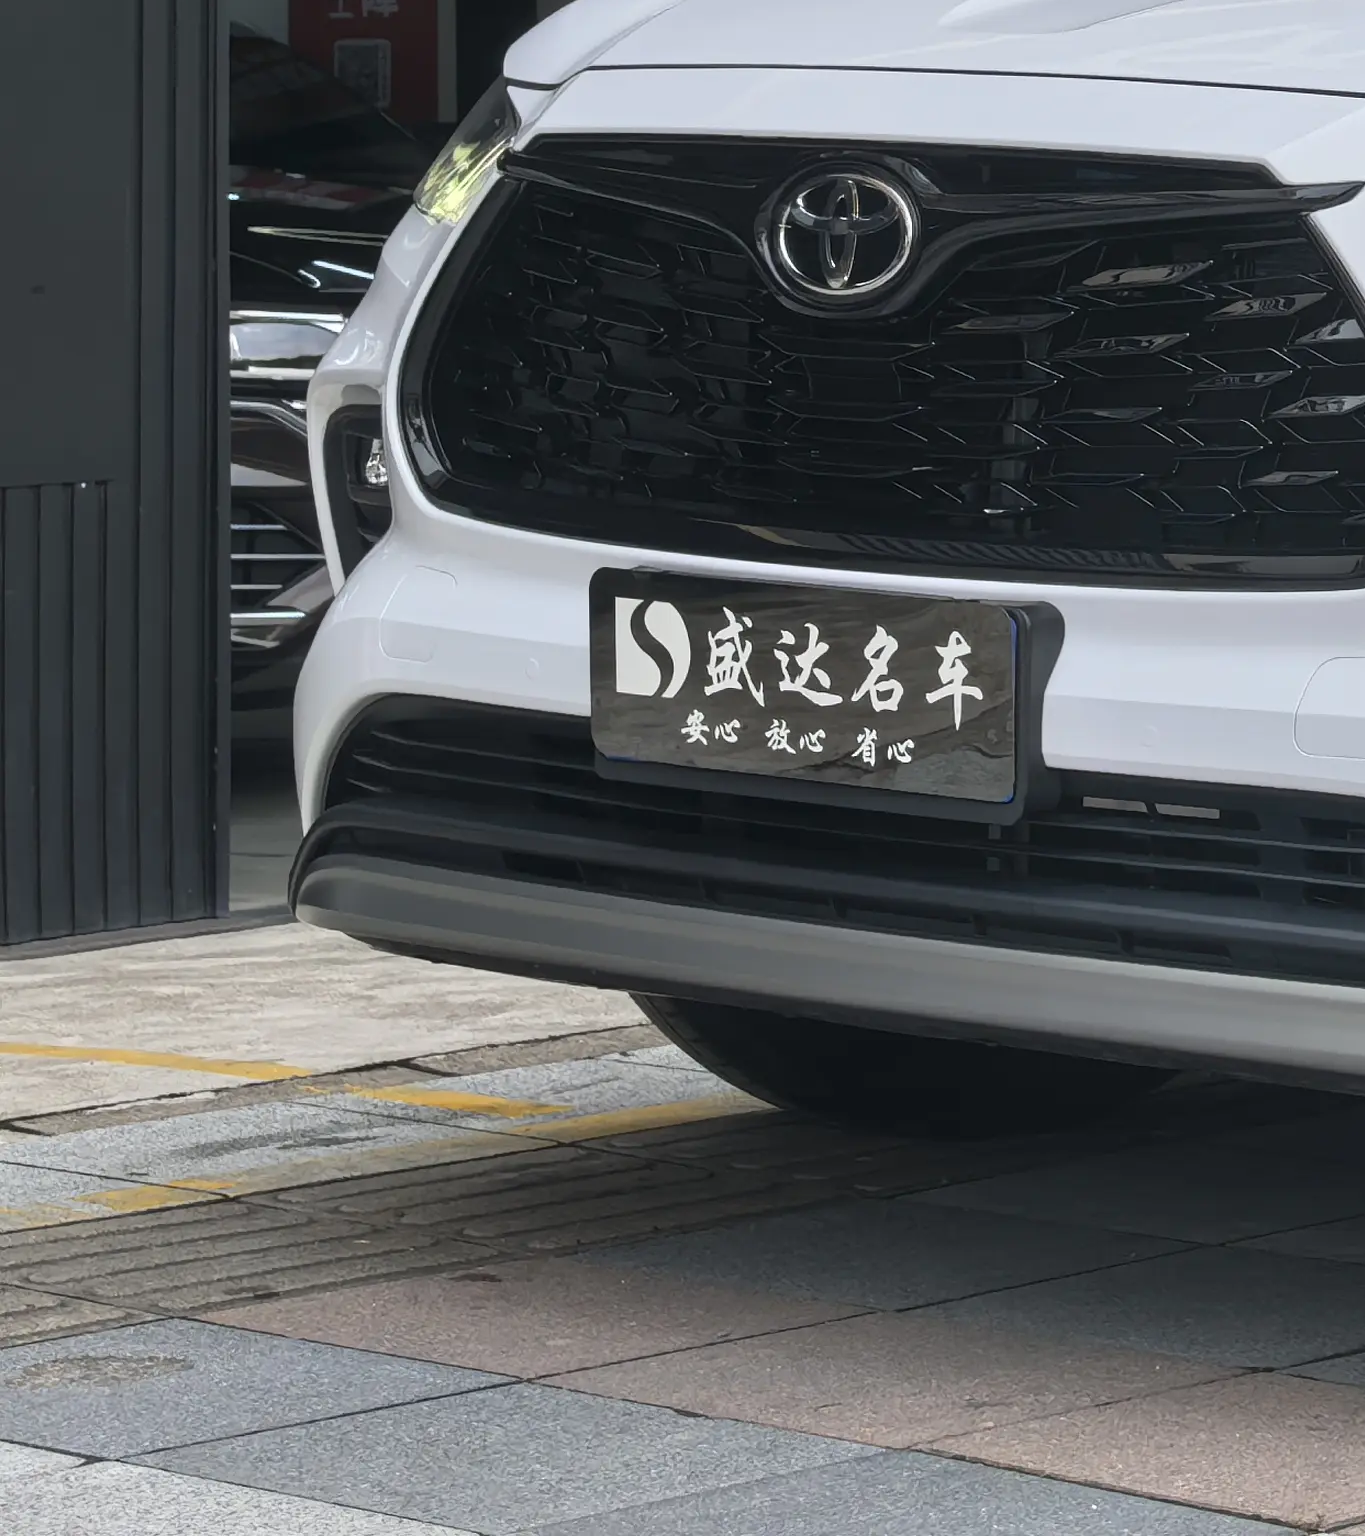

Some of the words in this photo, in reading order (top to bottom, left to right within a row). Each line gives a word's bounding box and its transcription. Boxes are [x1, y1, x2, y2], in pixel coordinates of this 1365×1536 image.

[704, 606, 984, 731] 盛达名车
[680, 709, 742, 746] 安心
[764, 718, 827, 755] 放心
[851, 727, 916, 767] 省心
